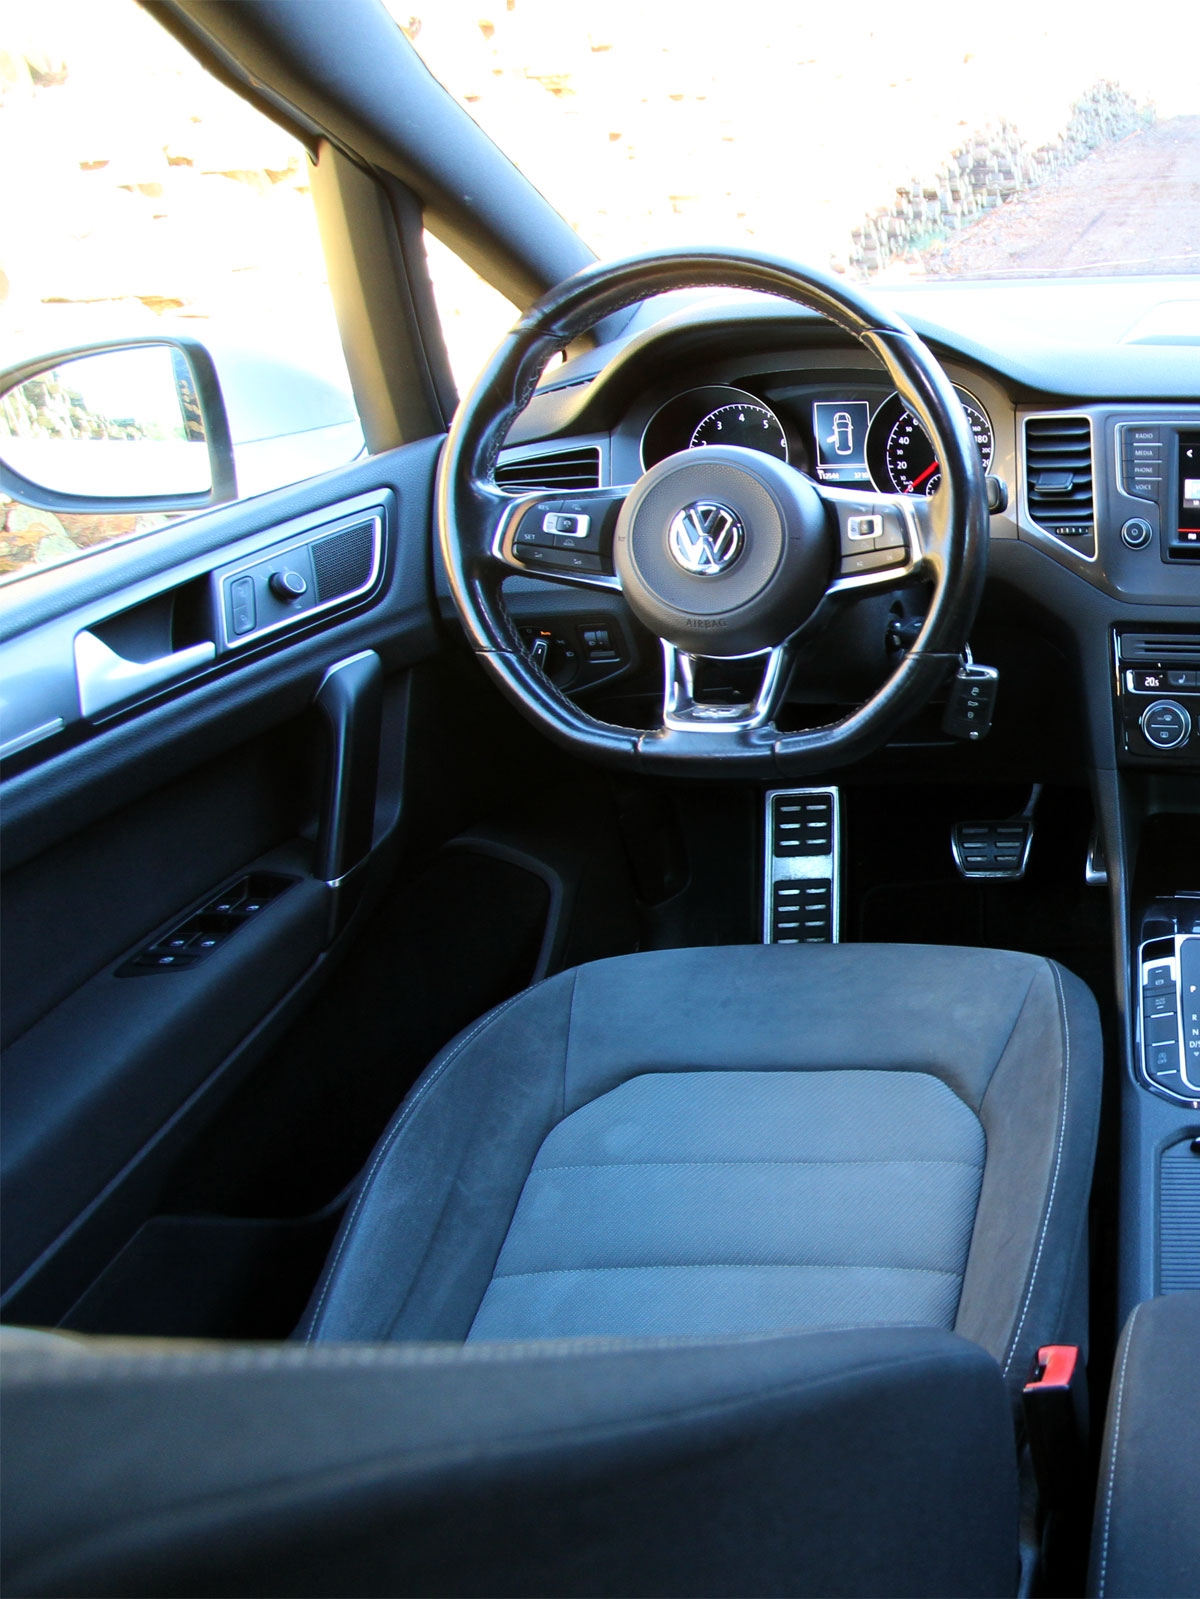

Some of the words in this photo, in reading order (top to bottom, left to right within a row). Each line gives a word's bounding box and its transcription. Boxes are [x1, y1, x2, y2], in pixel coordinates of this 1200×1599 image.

[738, 413, 745, 422] 4
[716, 421, 722, 430] 3
[763, 420, 769, 429] 5
[898, 436, 910, 445] 40
[896, 461, 908, 469] 20
[685, 618, 727, 628] AIRBAG
[1189, 985, 1197, 993] P
[1191, 1013, 1198, 1021] R
[1192, 1028, 1199, 1036] N
